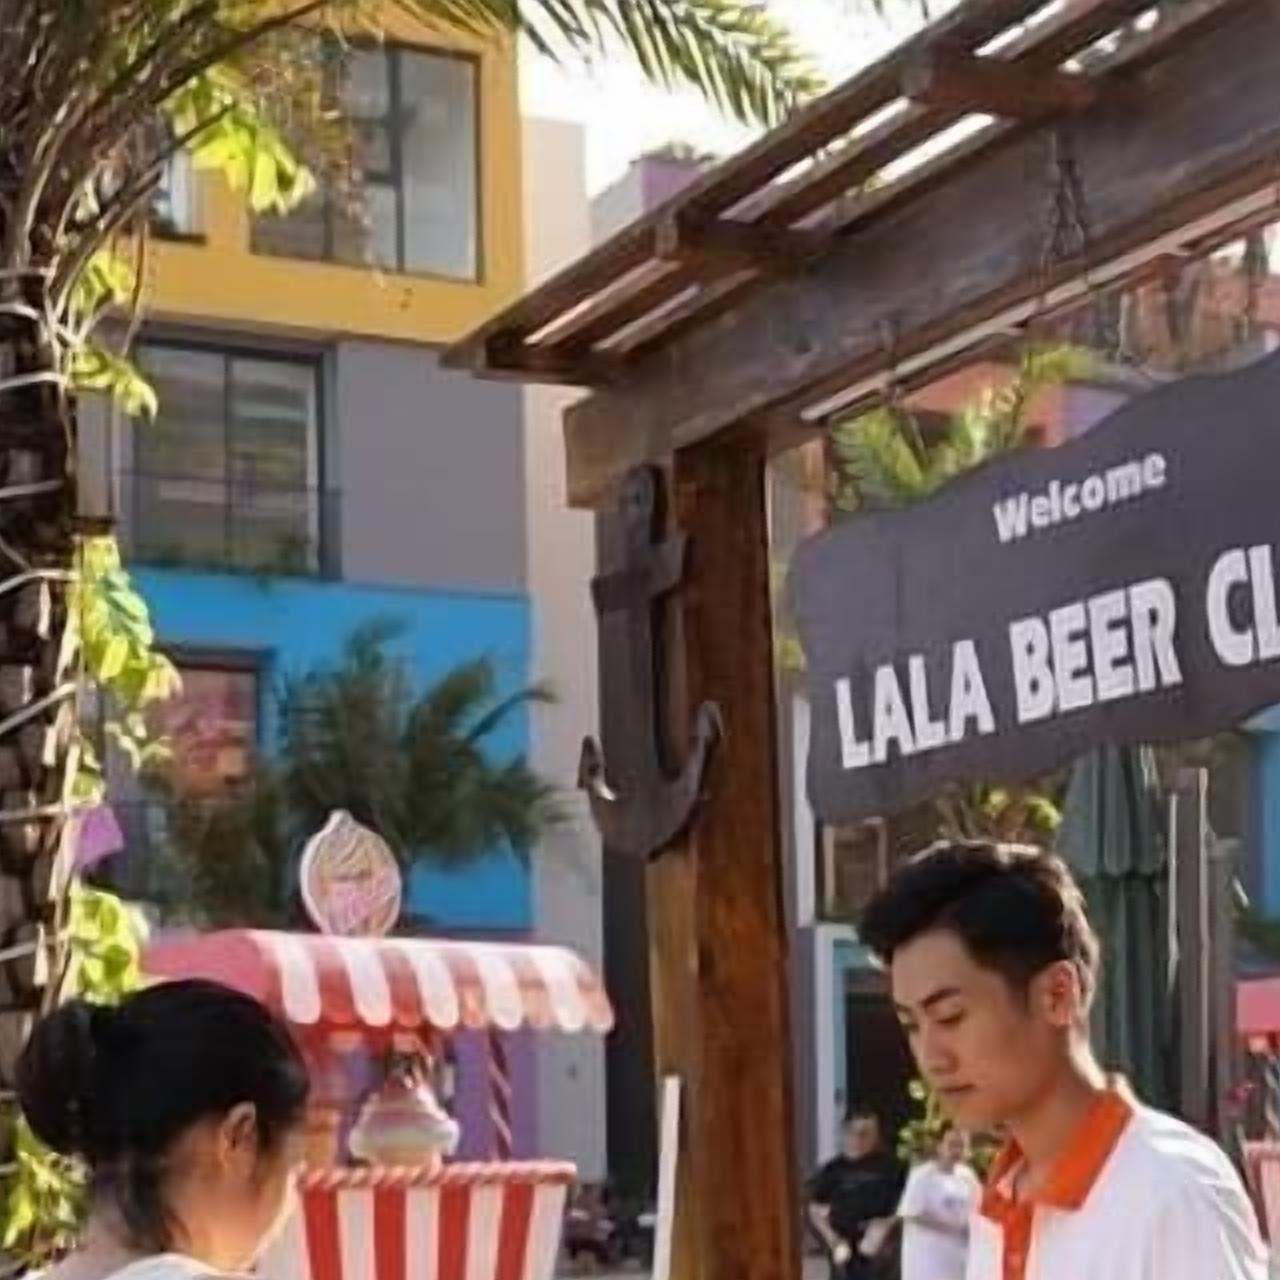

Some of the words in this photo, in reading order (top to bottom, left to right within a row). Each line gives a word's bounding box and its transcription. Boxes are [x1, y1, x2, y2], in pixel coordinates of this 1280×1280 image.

[992, 452, 1167, 543] Welcome
[835, 639, 995, 769] LALA
[1009, 576, 1183, 724] BEER
